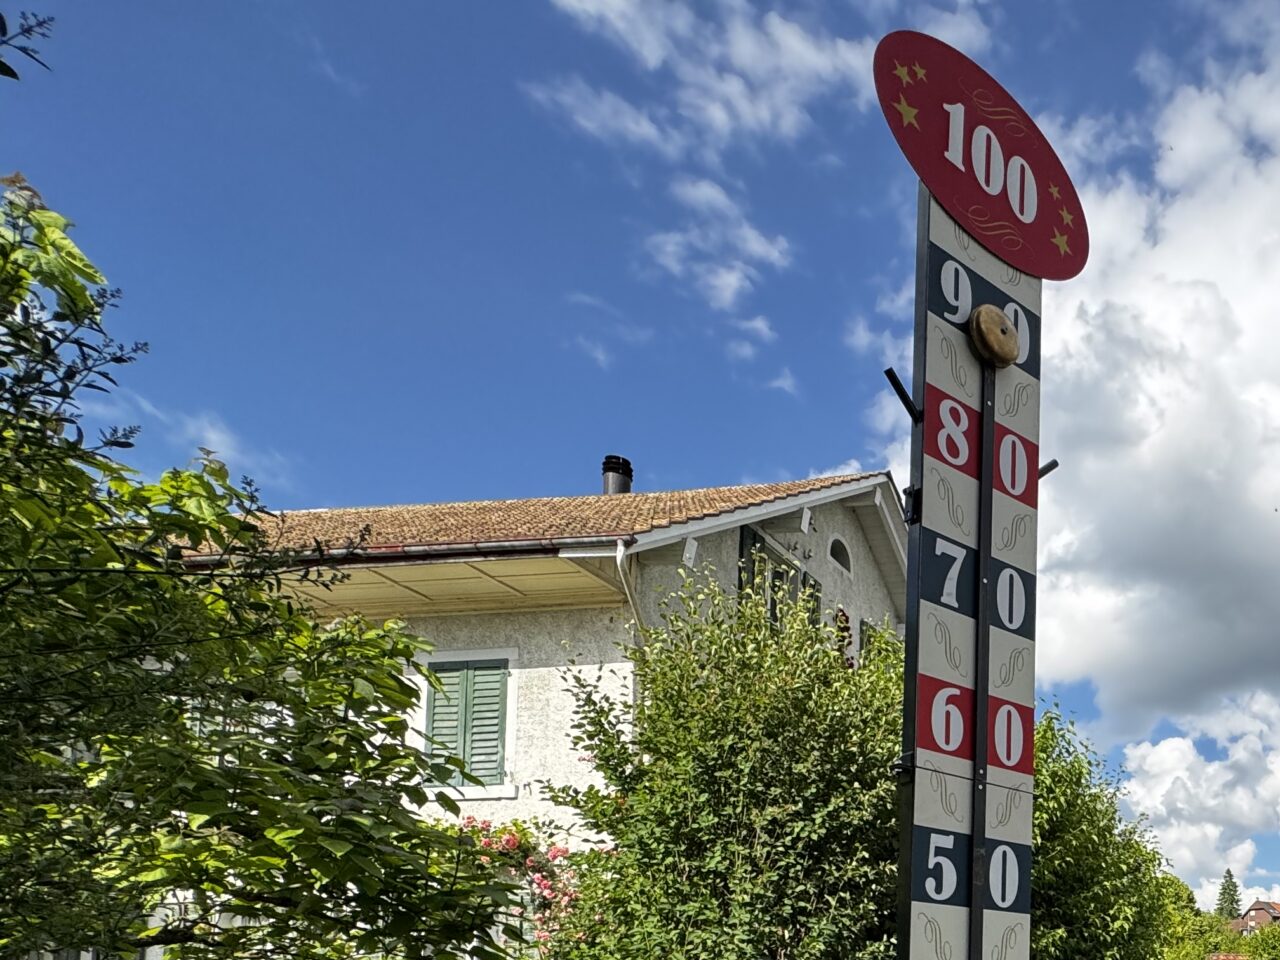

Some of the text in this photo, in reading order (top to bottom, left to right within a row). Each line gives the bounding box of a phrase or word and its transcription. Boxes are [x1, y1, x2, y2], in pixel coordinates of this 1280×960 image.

[942, 102, 1038, 224] 100
[937, 399, 1028, 496] 80
[935, 538, 1026, 630] 70
[931, 687, 1024, 767] 60
[925, 833, 1019, 909] 50
